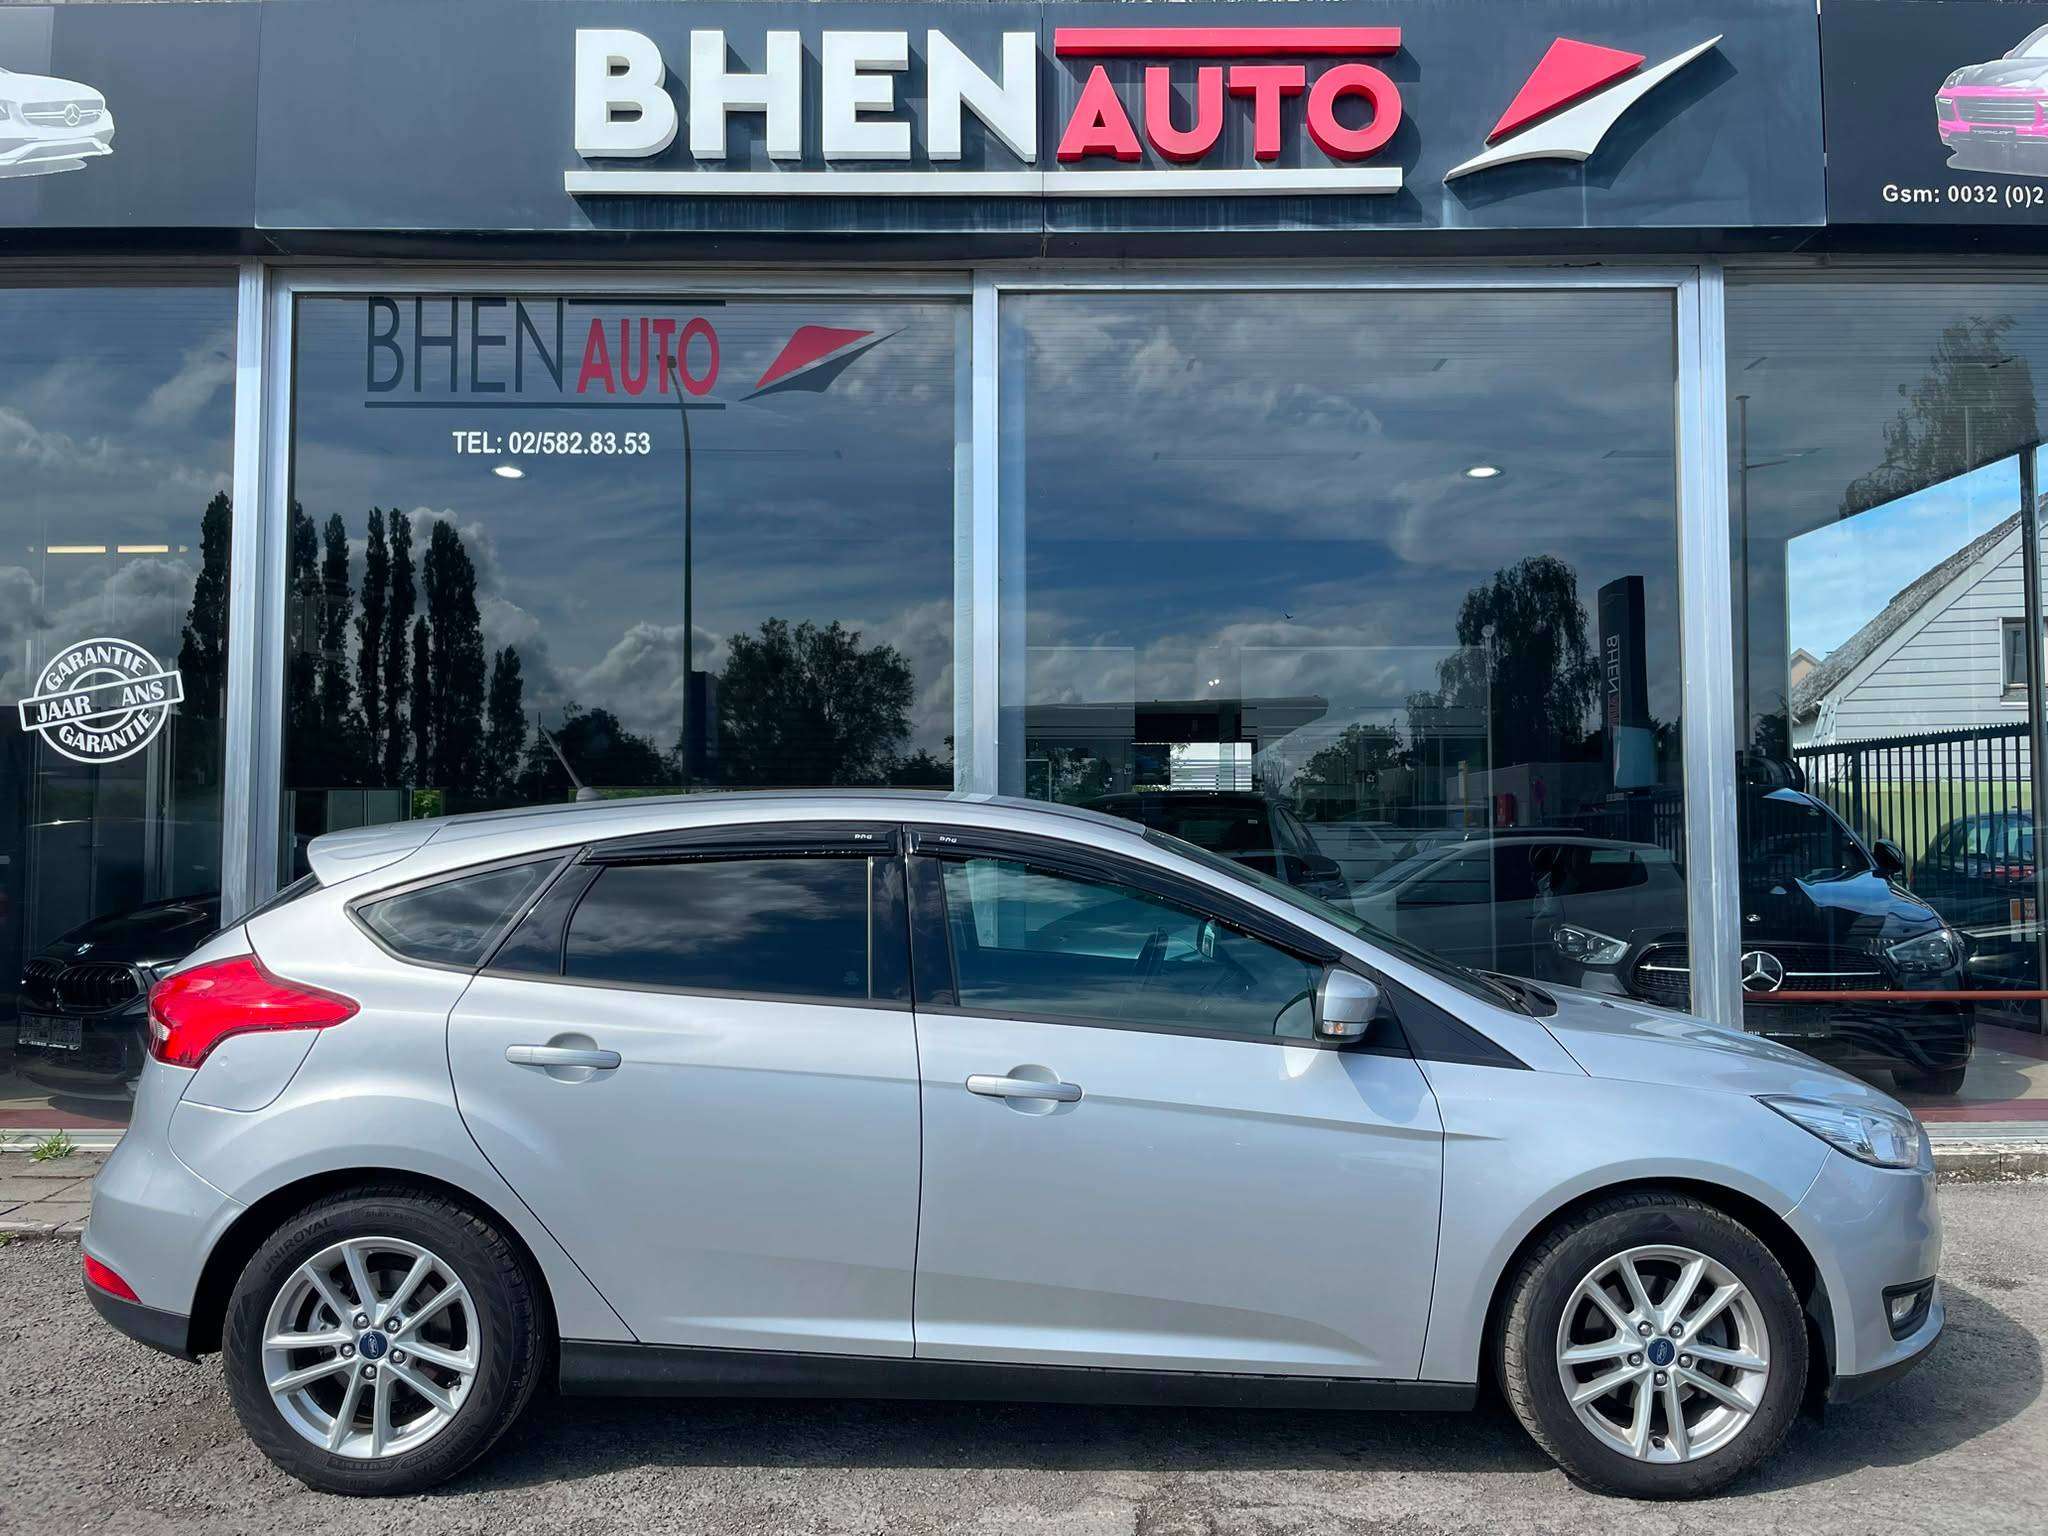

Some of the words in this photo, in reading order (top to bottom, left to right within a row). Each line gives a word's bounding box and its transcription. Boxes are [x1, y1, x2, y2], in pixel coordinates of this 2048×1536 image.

[575, 29, 1036, 162] BHEN
[1058, 64, 1403, 163] AUTO
[1882, 184, 1940, 204] Gsm:
[1947, 184, 1998, 205] 0032
[2005, 185, 2044, 209] (0)2
[366, 297, 563, 393] BHEN
[577, 316, 720, 396] AUTO
[452, 431, 502, 454] TEL:
[508, 432, 651, 455] 02/582.83.53
[46, 645, 147, 691] GARANTIE
[37, 695, 92, 724] JAAR
[121, 680, 166, 707] ANS
[58, 709, 155, 753] GARANTIE
